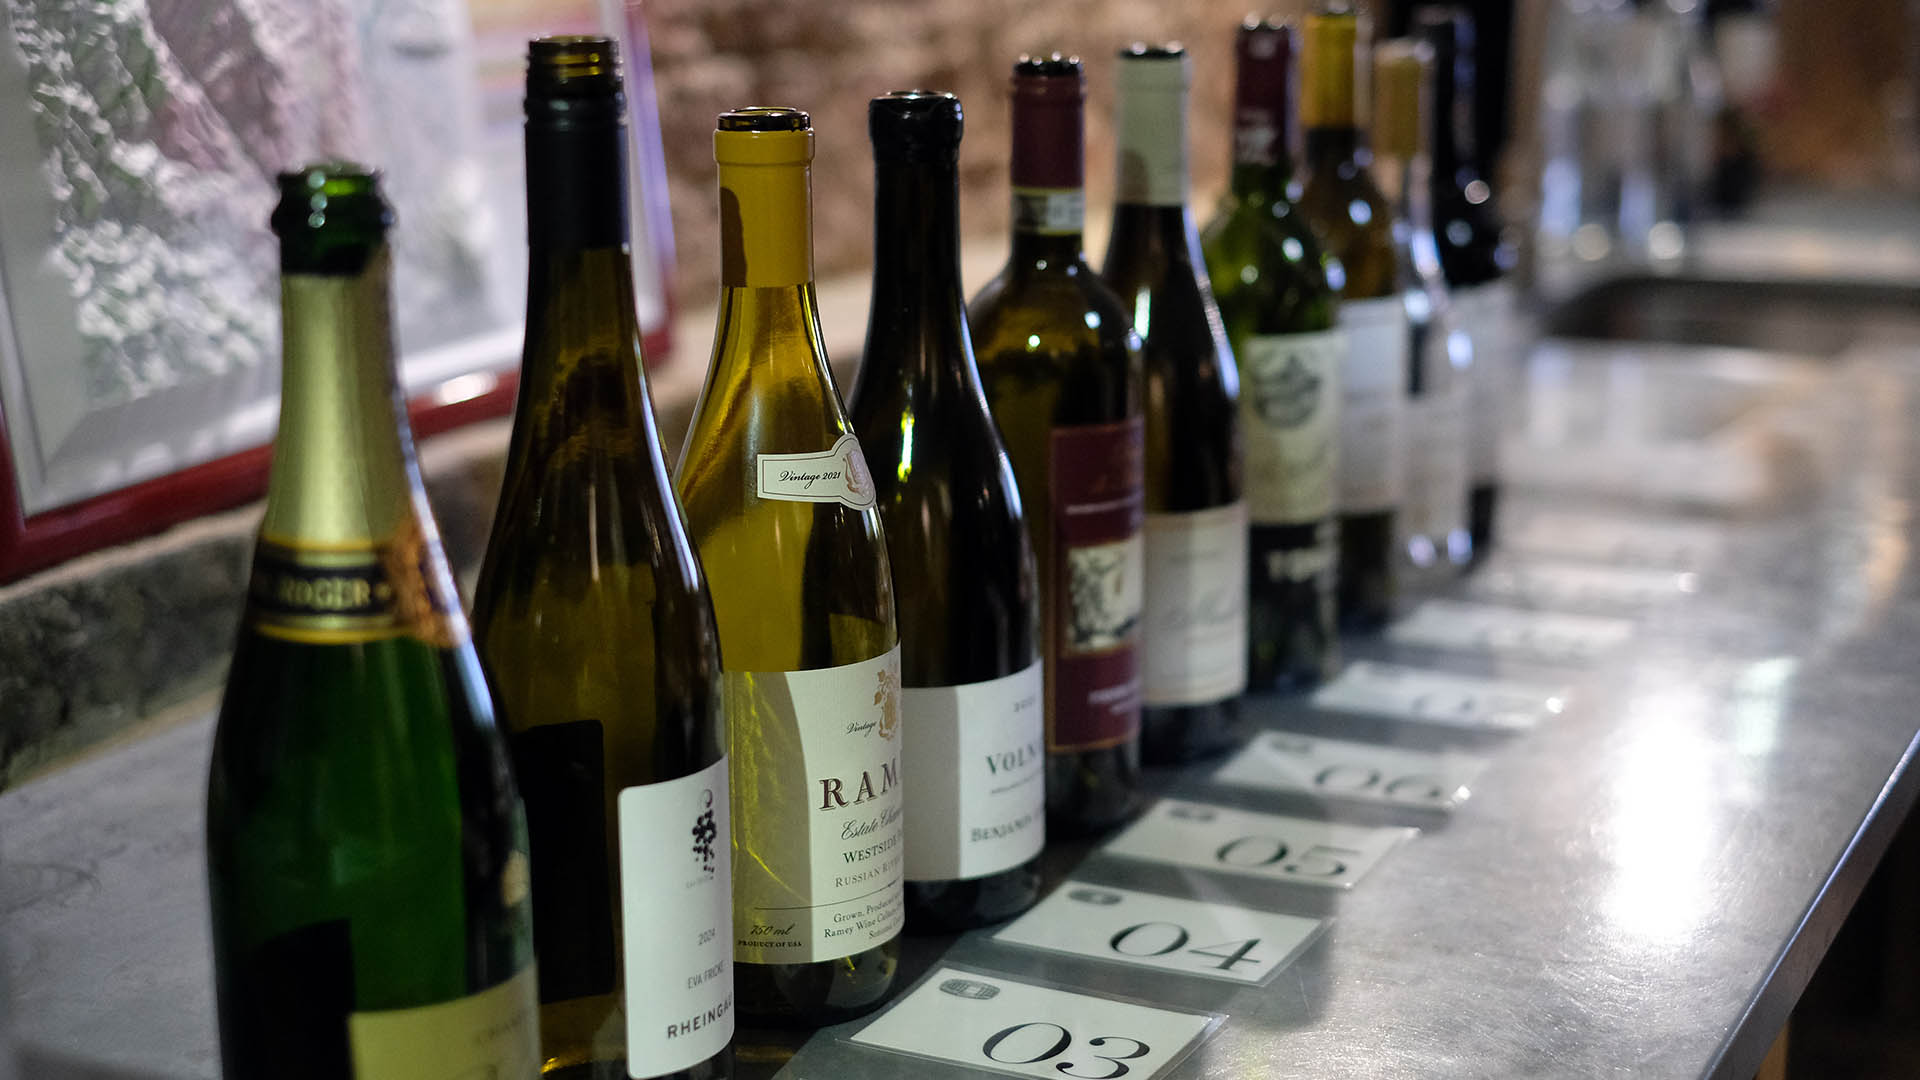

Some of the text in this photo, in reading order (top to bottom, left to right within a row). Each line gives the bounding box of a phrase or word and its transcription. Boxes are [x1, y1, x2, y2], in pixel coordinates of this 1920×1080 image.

[779, 469, 841, 489] Vintage 2021
[846, 721, 877, 737] Vintage
[841, 819, 879, 840] Estate
[1215, 834, 1362, 877] 05
[835, 866, 881, 888] RUSSIAN
[750, 922, 796, 935] 750 ml
[824, 926, 854, 938] Ramey
[856, 918, 876, 930] Wine
[1109, 920, 1262, 971] 04
[687, 974, 703, 990] EVA
[980, 1021, 1151, 1080] 03
